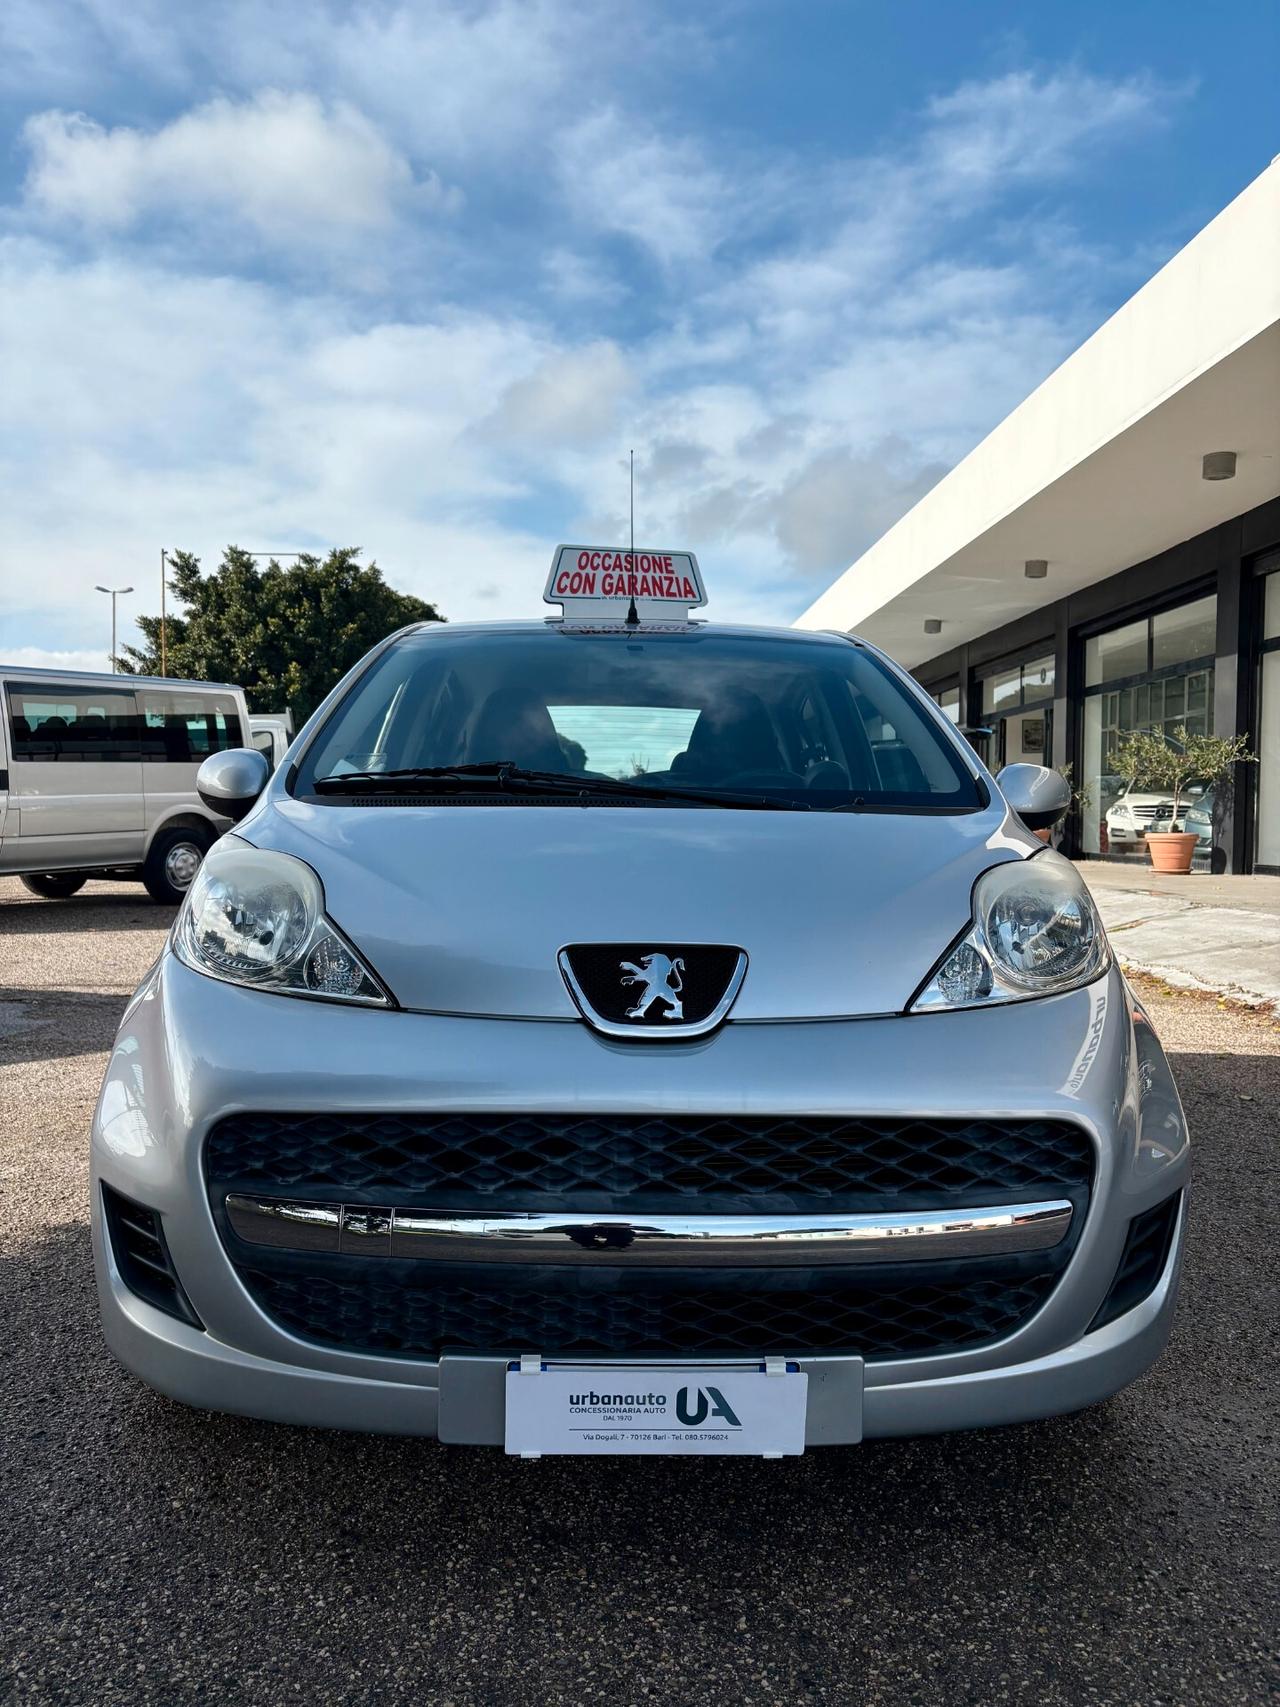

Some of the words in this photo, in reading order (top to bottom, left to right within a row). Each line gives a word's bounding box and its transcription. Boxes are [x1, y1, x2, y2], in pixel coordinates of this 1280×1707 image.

[578, 551, 675, 574] OCCASIONE
[556, 571, 596, 595] CON
[602, 573, 696, 598] GARANZIA
[569, 1391, 667, 1406] urbanauto
[582, 1433, 594, 1441] Via
[620, 1433, 625, 1441] 7
[630, 1433, 652, 1441] 70126
[652, 1433, 667, 1441] Bari
[684, 1433, 729, 1441] 080.5796024
